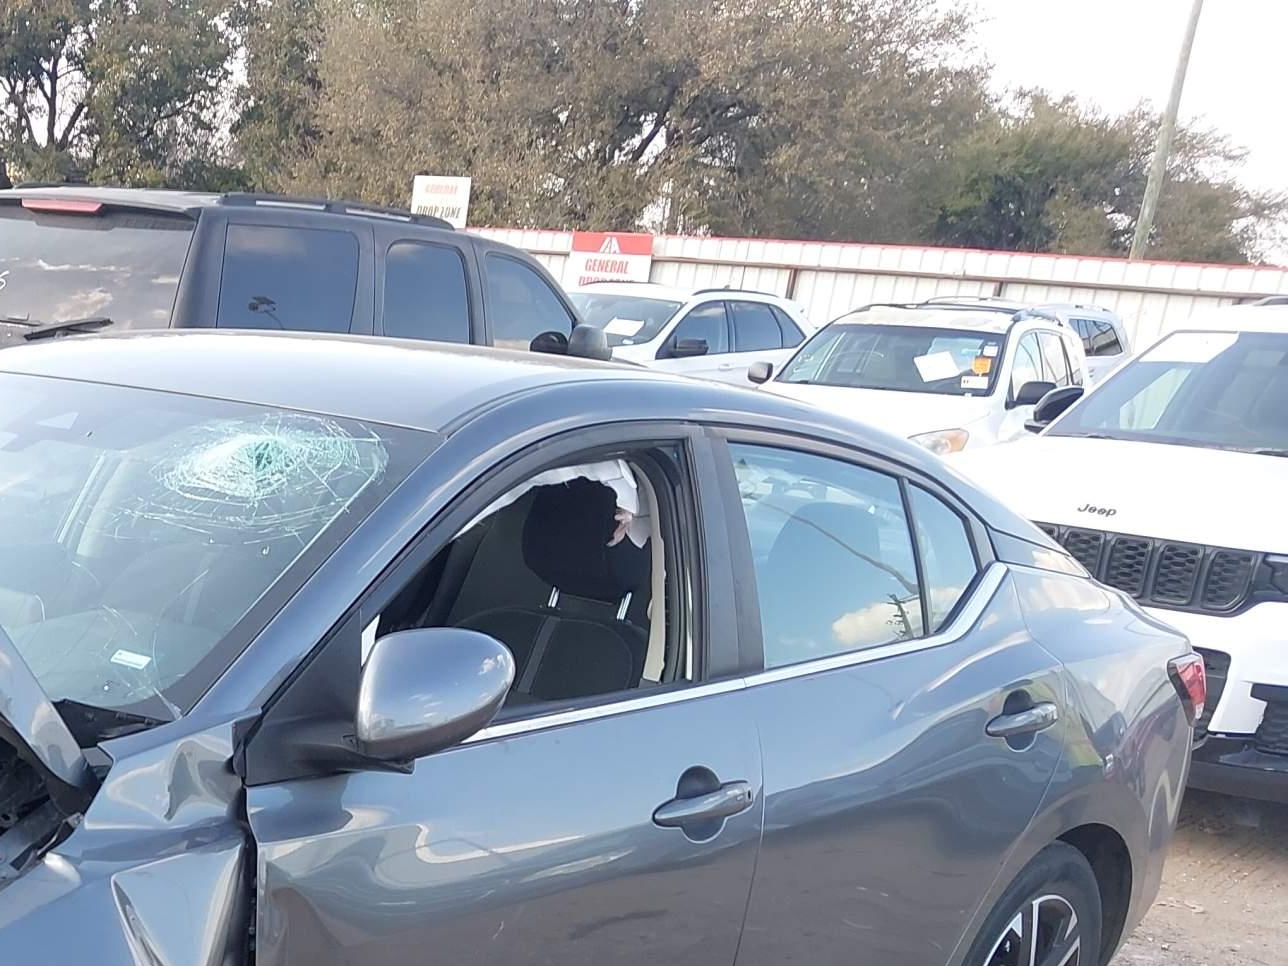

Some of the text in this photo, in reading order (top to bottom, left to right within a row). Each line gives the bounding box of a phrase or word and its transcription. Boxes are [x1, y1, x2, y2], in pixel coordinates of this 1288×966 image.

[440, 206, 461, 219] ZONE
[585, 258, 630, 274] GENERAL
[1077, 503, 1117, 518] Jeep
